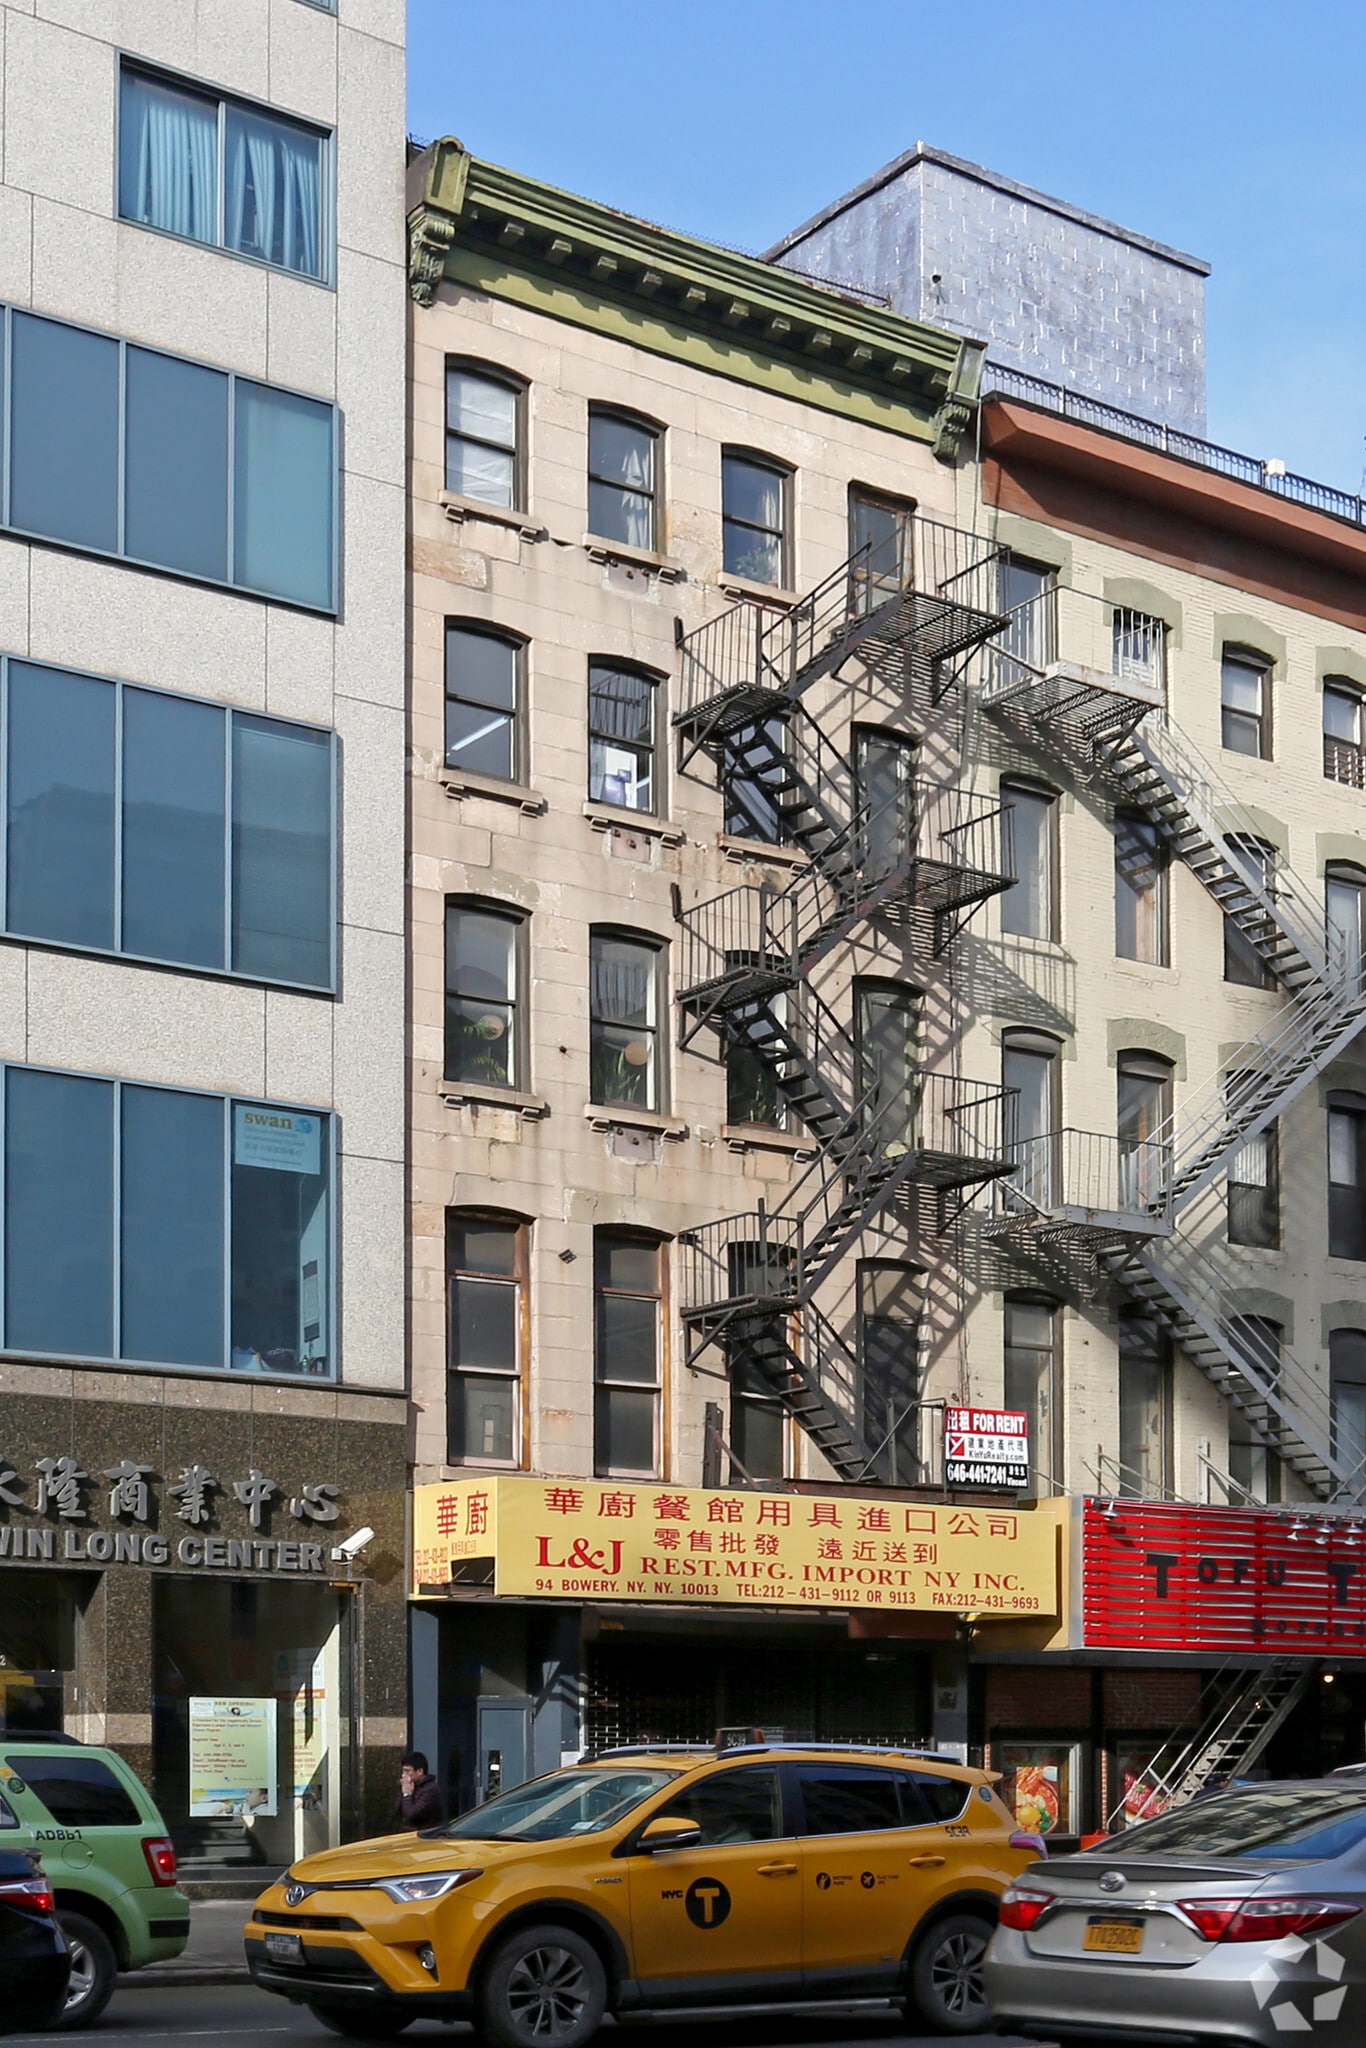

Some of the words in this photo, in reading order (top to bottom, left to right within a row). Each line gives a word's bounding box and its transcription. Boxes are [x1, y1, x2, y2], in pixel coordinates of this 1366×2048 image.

[244, 1113, 292, 1129] swan
[947, 1410, 970, 1431] 出租
[973, 1413, 994, 1432] FOR
[996, 1414, 1025, 1434] RENT
[947, 1463, 1006, 1485] 646-441-7241
[65, 1530, 167, 1563] LONG
[179, 1536, 323, 1571] CENTER
[653, 1527, 779, 1556] 零售批發
[817, 1537, 937, 1565] 遠近送到
[535, 1536, 625, 1575] L&J
[802, 1564, 912, 1587] IMPORT
[924, 1570, 961, 1588] NY
[973, 1573, 1025, 1591] INC.
[1146, 1553, 1285, 1598] TOFU
[535, 1579, 553, 1591] 94
[562, 1579, 620, 1593] BOWERY.
[627, 1581, 647, 1593] NY.
[654, 1582, 673, 1594] NY.
[681, 1583, 719, 1596] 10013
[866, 1590, 882, 1603] OR
[889, 1591, 916, 1604] 9113
[661, 1890, 684, 1899] NYC
